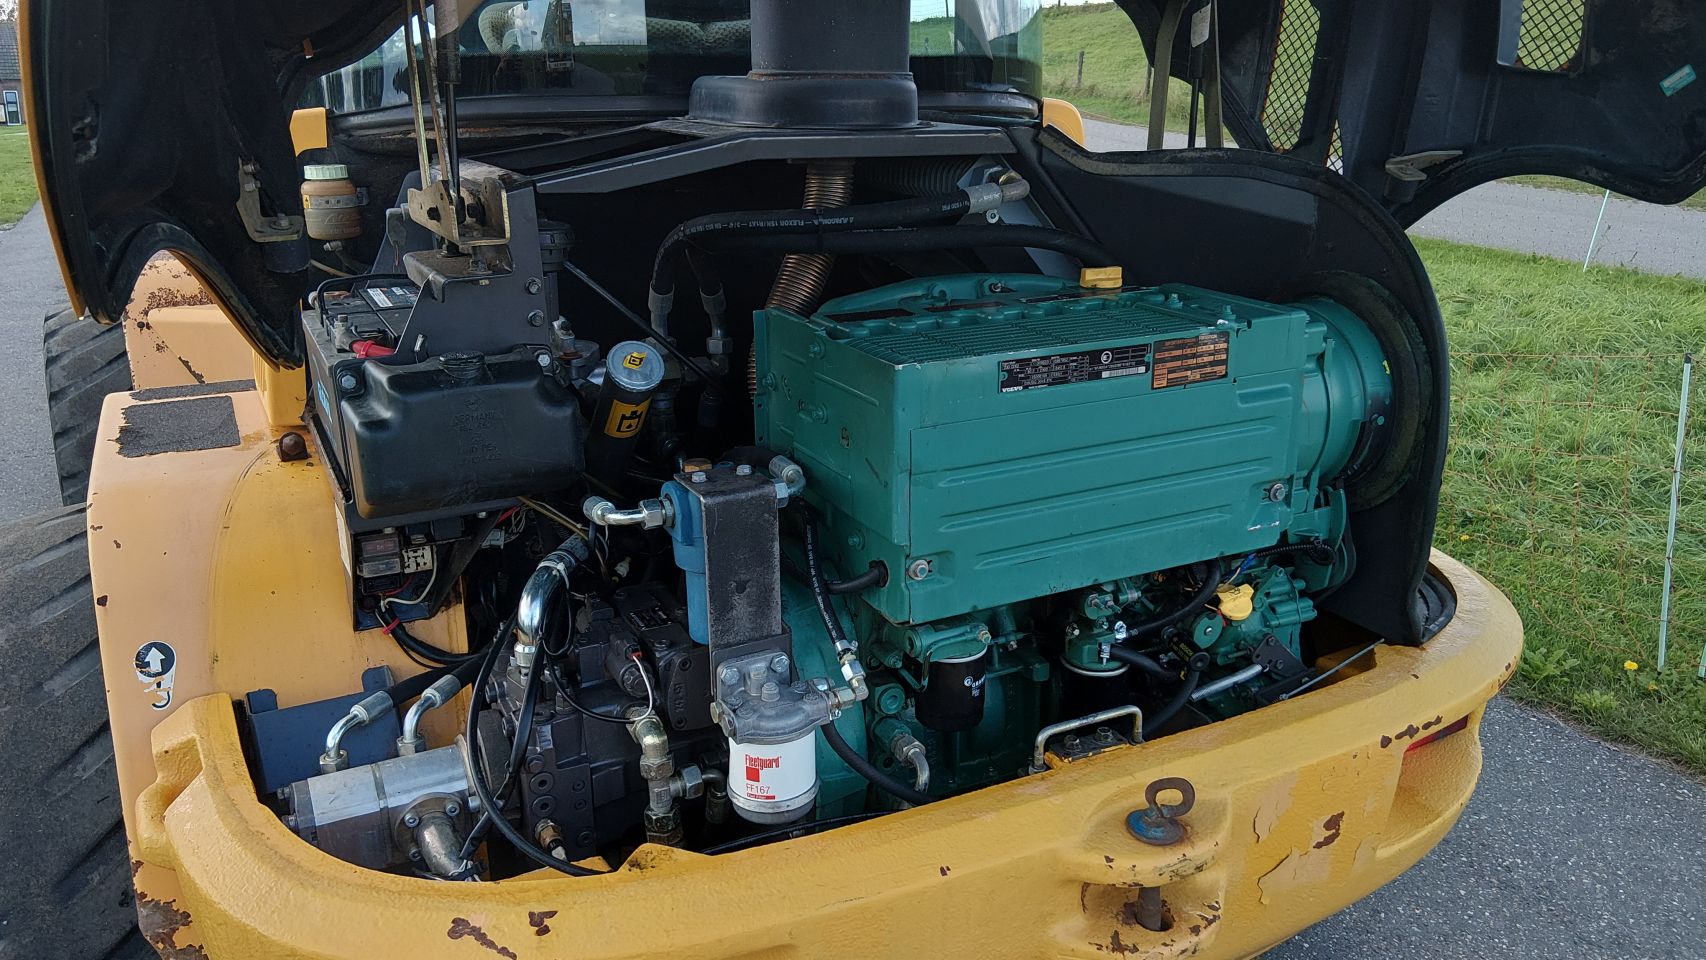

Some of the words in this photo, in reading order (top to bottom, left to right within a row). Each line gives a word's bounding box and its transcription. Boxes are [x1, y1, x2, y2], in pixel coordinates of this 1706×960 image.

[779, 219, 804, 227] FLEXOR
[745, 754, 779, 771] Fleetguard
[746, 783, 770, 794] FF167
